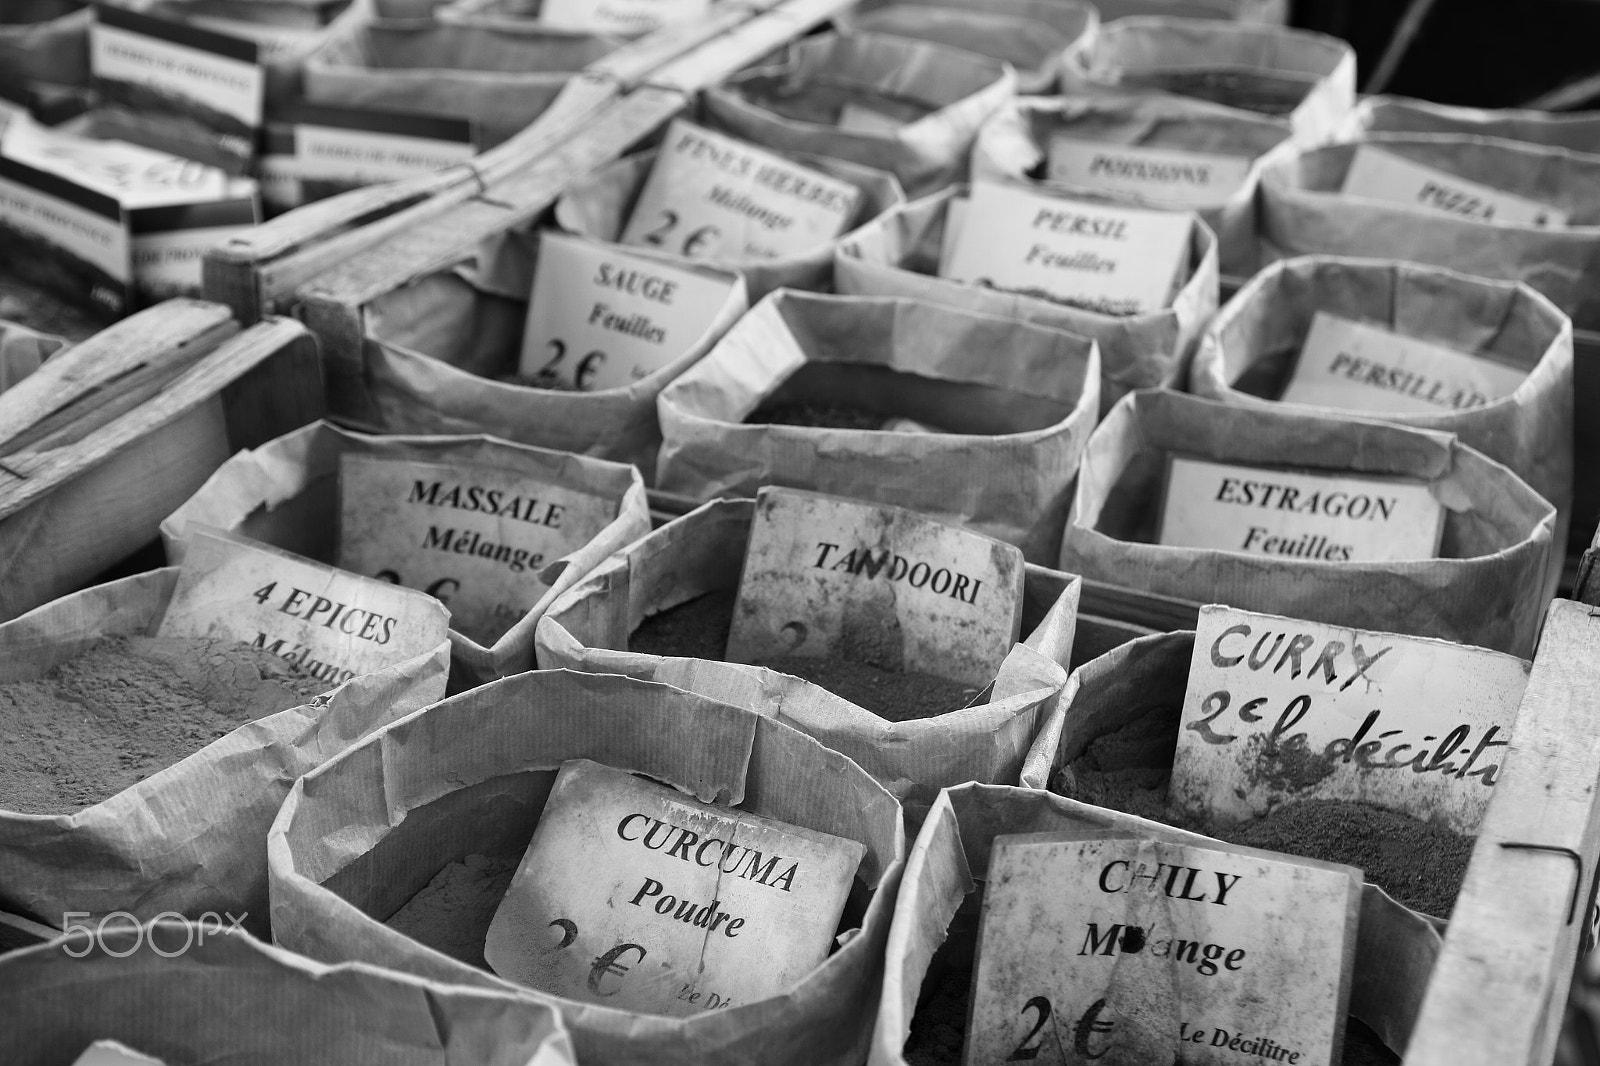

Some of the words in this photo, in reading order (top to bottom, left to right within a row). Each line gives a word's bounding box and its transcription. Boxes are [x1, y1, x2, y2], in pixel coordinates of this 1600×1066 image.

[1031, 207, 1128, 242] PERSIL
[593, 261, 679, 305] SAUGE
[586, 300, 666, 344] Feuilles
[537, 338, 567, 378] 2
[1328, 350, 1490, 408] PERSILLAD
[407, 480, 566, 530] MASSALE
[1215, 477, 1397, 522] ESTRAGON
[422, 525, 544, 573] Mélange
[1242, 526, 1355, 561] Feuilles
[812, 541, 983, 606] TANDOORI
[253, 581, 279, 606] 4
[277, 586, 399, 646] EPICES
[1210, 624, 1394, 693] CURRY
[616, 812, 801, 893] CURCUMA
[628, 876, 746, 938] Poudre
[1006, 995, 1053, 1063] 2
[1180, 1021, 1205, 1045] Le
[1210, 1026, 1302, 1066] Décilitre
